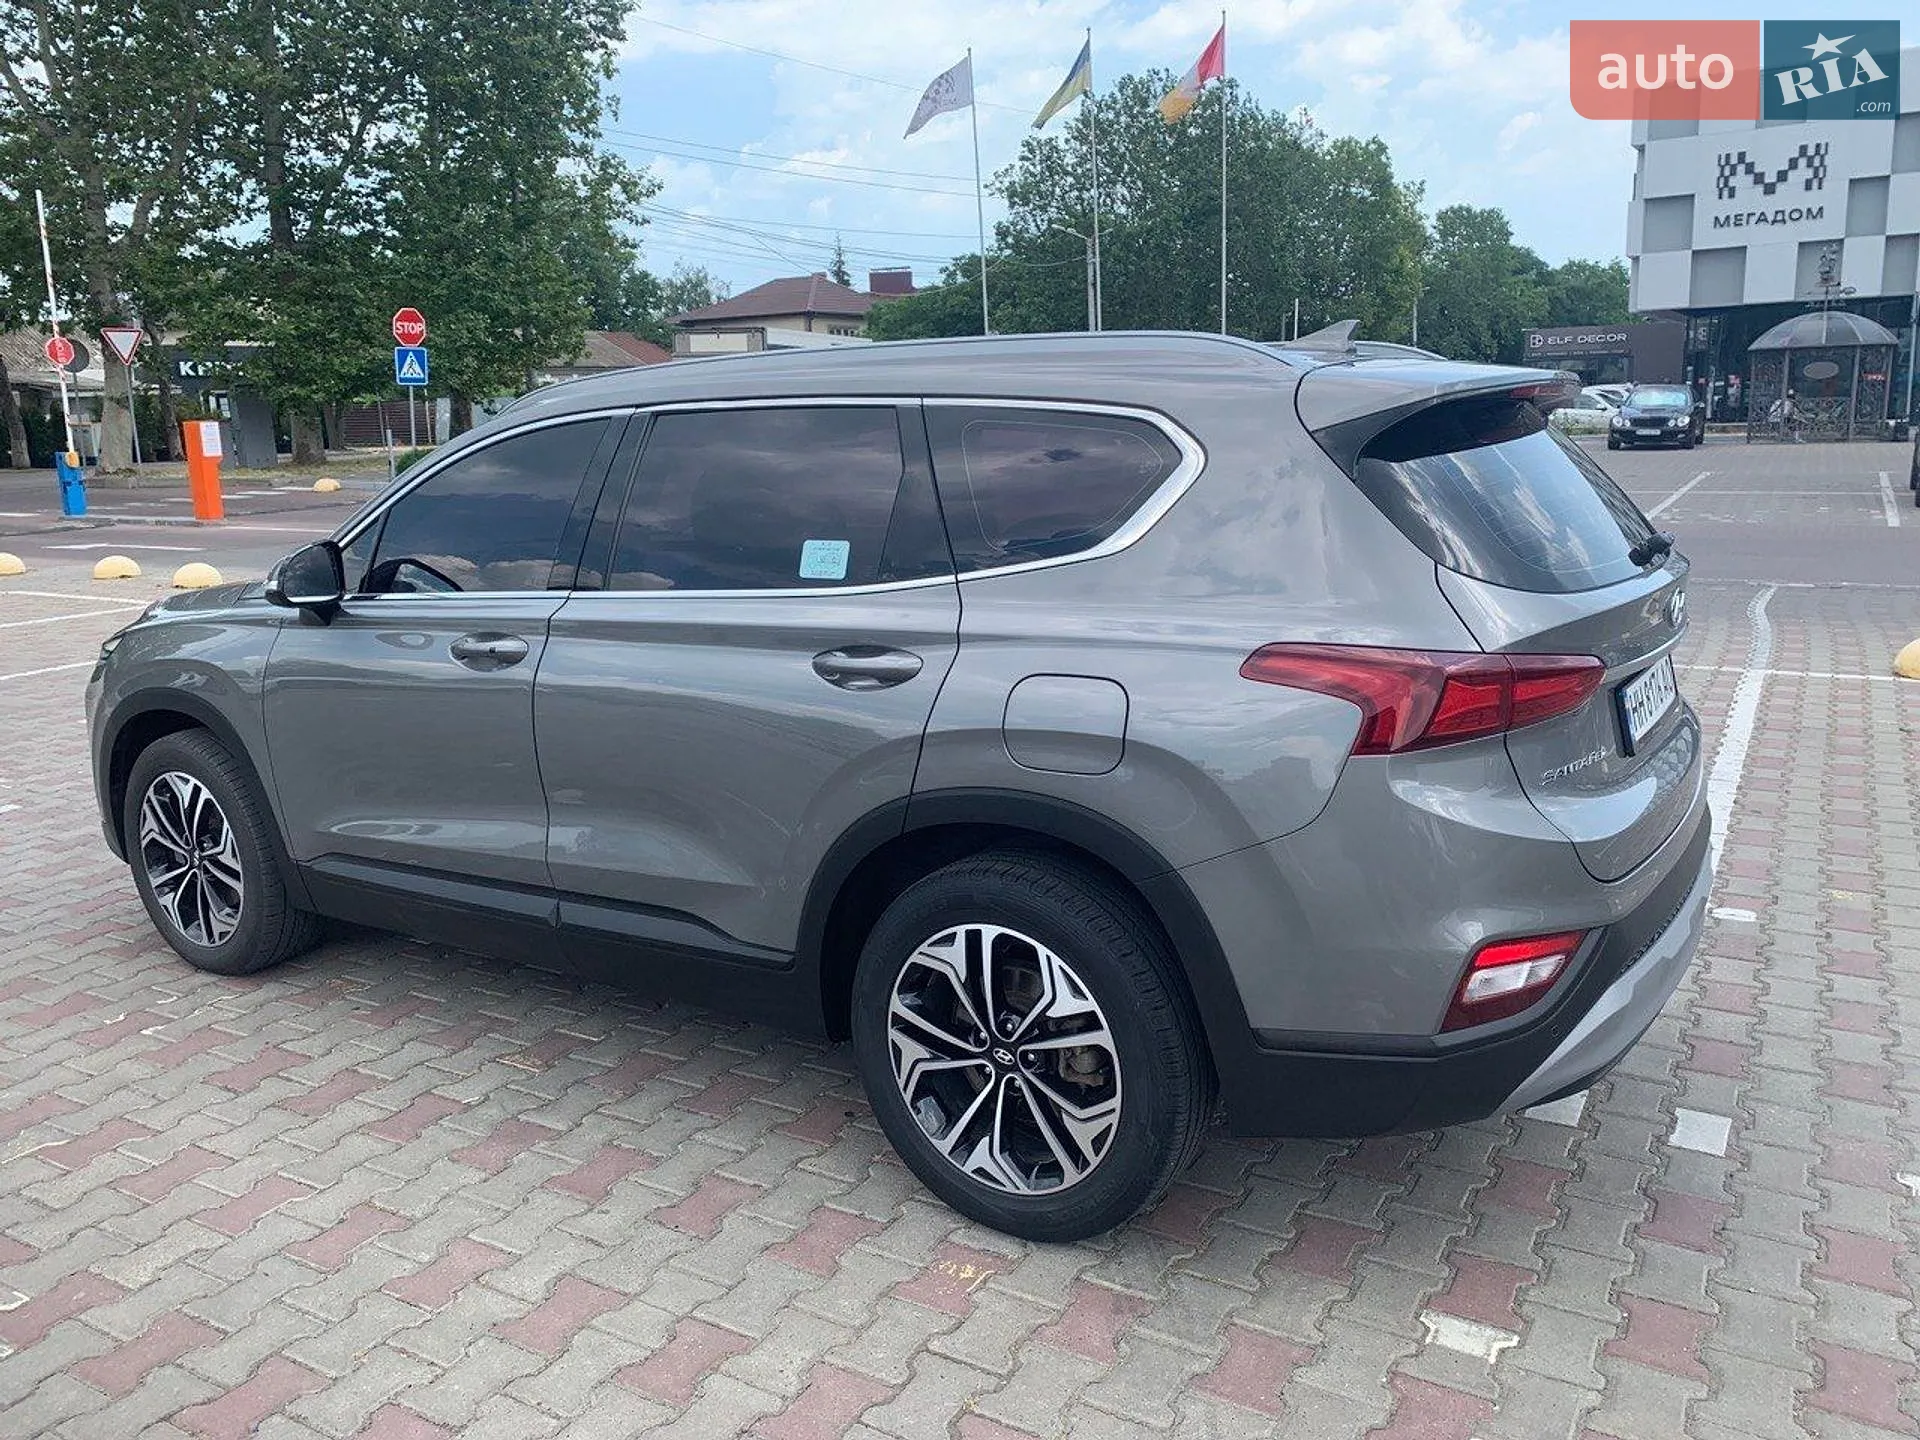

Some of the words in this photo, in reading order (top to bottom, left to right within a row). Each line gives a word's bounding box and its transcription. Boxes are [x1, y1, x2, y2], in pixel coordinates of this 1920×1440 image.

[1712, 206, 1824, 229] МЕГАДОМ
[395, 322, 423, 335] STOP
[1546, 336, 1574, 345] ELF
[1577, 333, 1628, 344] DECOR
